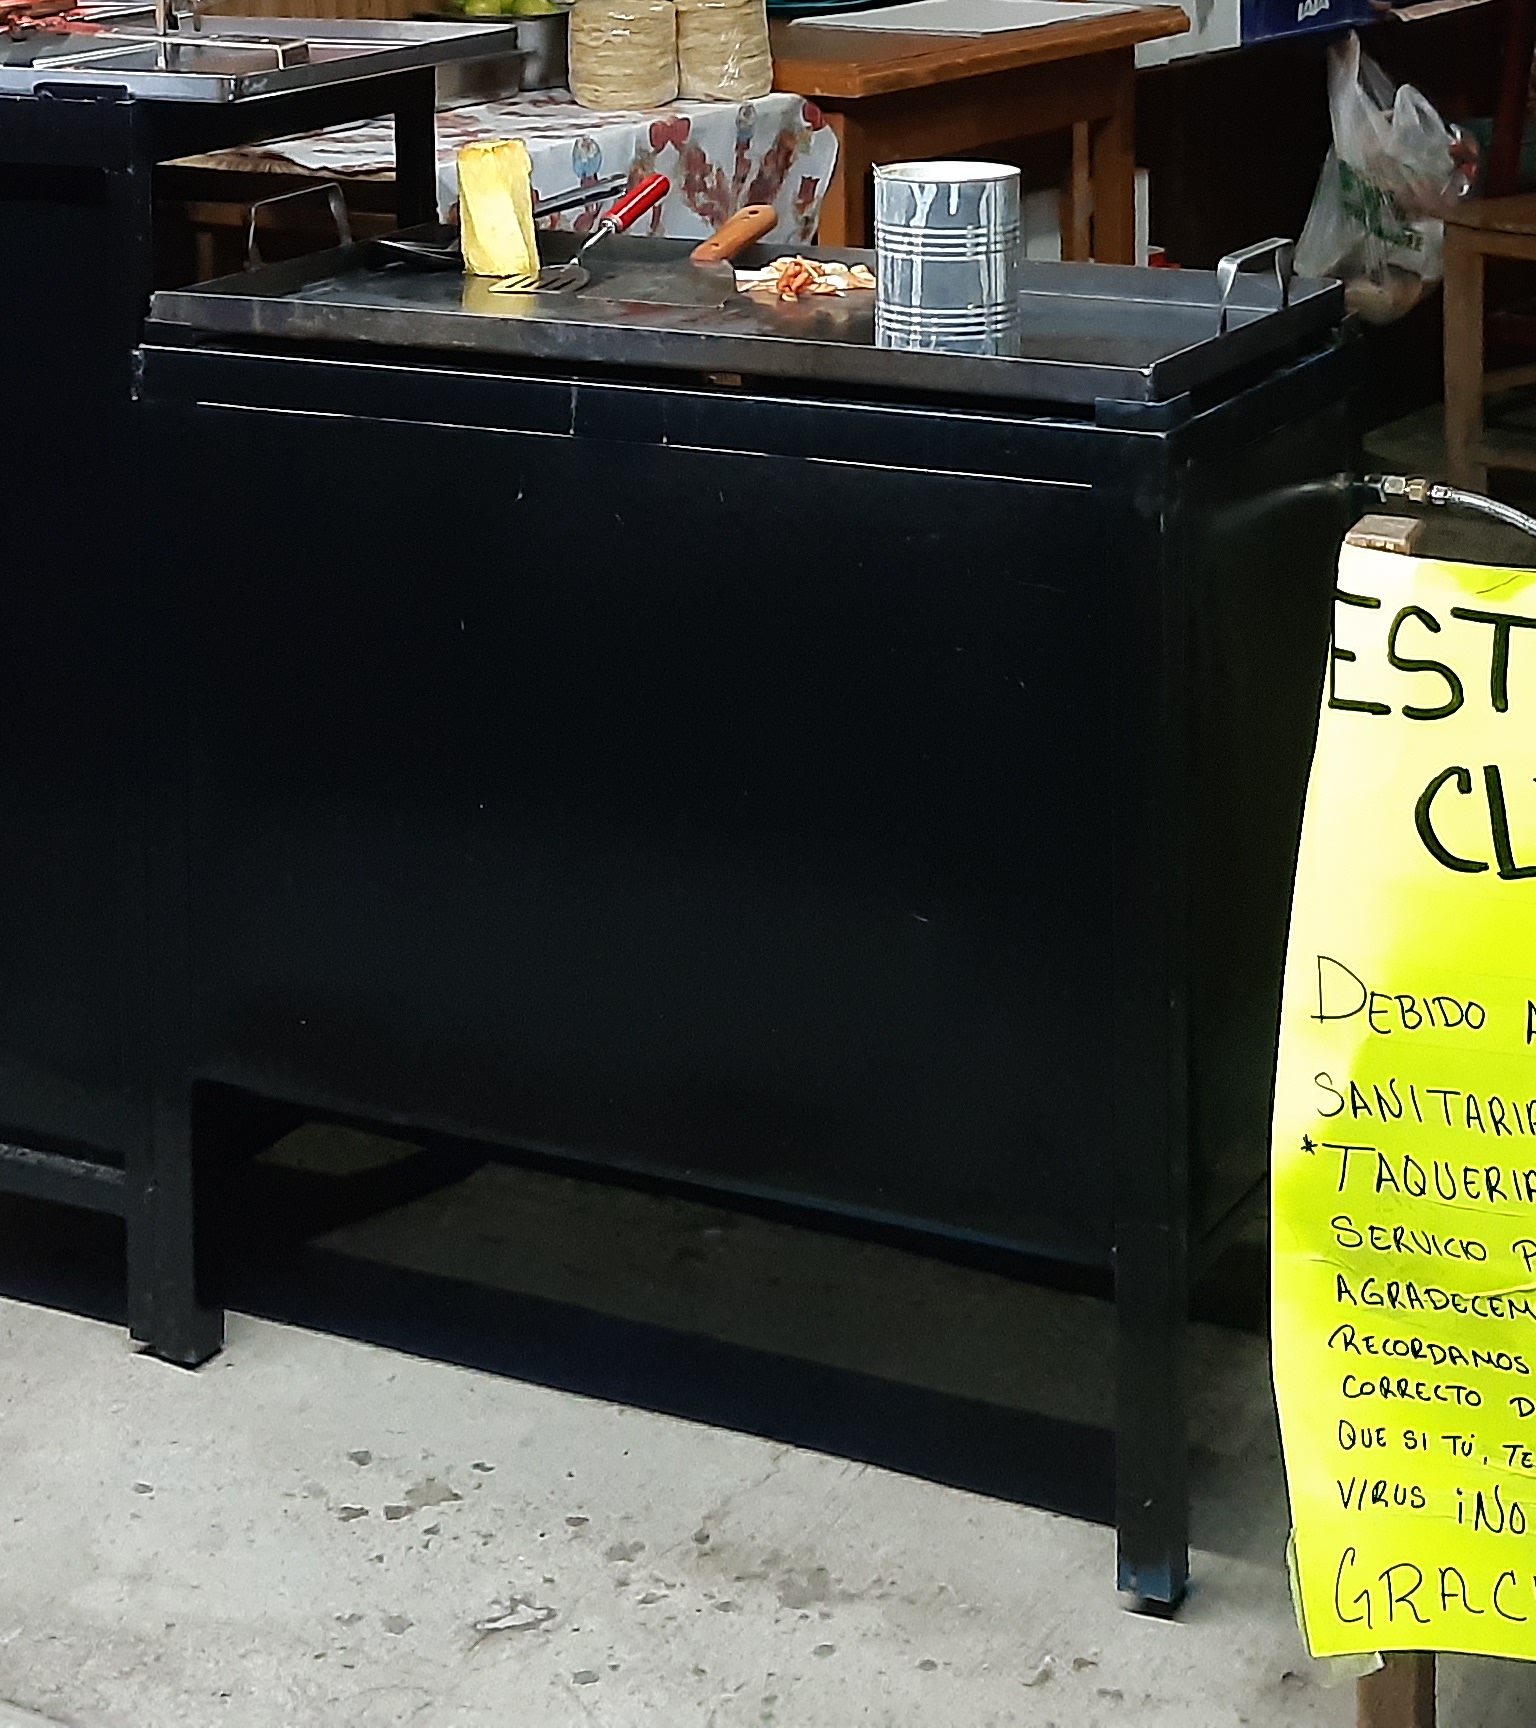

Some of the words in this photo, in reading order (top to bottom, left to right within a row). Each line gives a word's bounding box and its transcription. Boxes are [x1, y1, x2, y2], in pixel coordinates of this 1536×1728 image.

[1310, 955, 1486, 1035] DEBIDO
[1327, 1323, 1530, 1375] RECORDAMOS
[1342, 1374, 1482, 1407] CORRECTO
[1338, 1419, 1387, 1451] QUE
[1402, 1429, 1427, 1451] SI
[1502, 1444, 1533, 1469] TE
[1336, 1476, 1426, 1511] VIRUS
